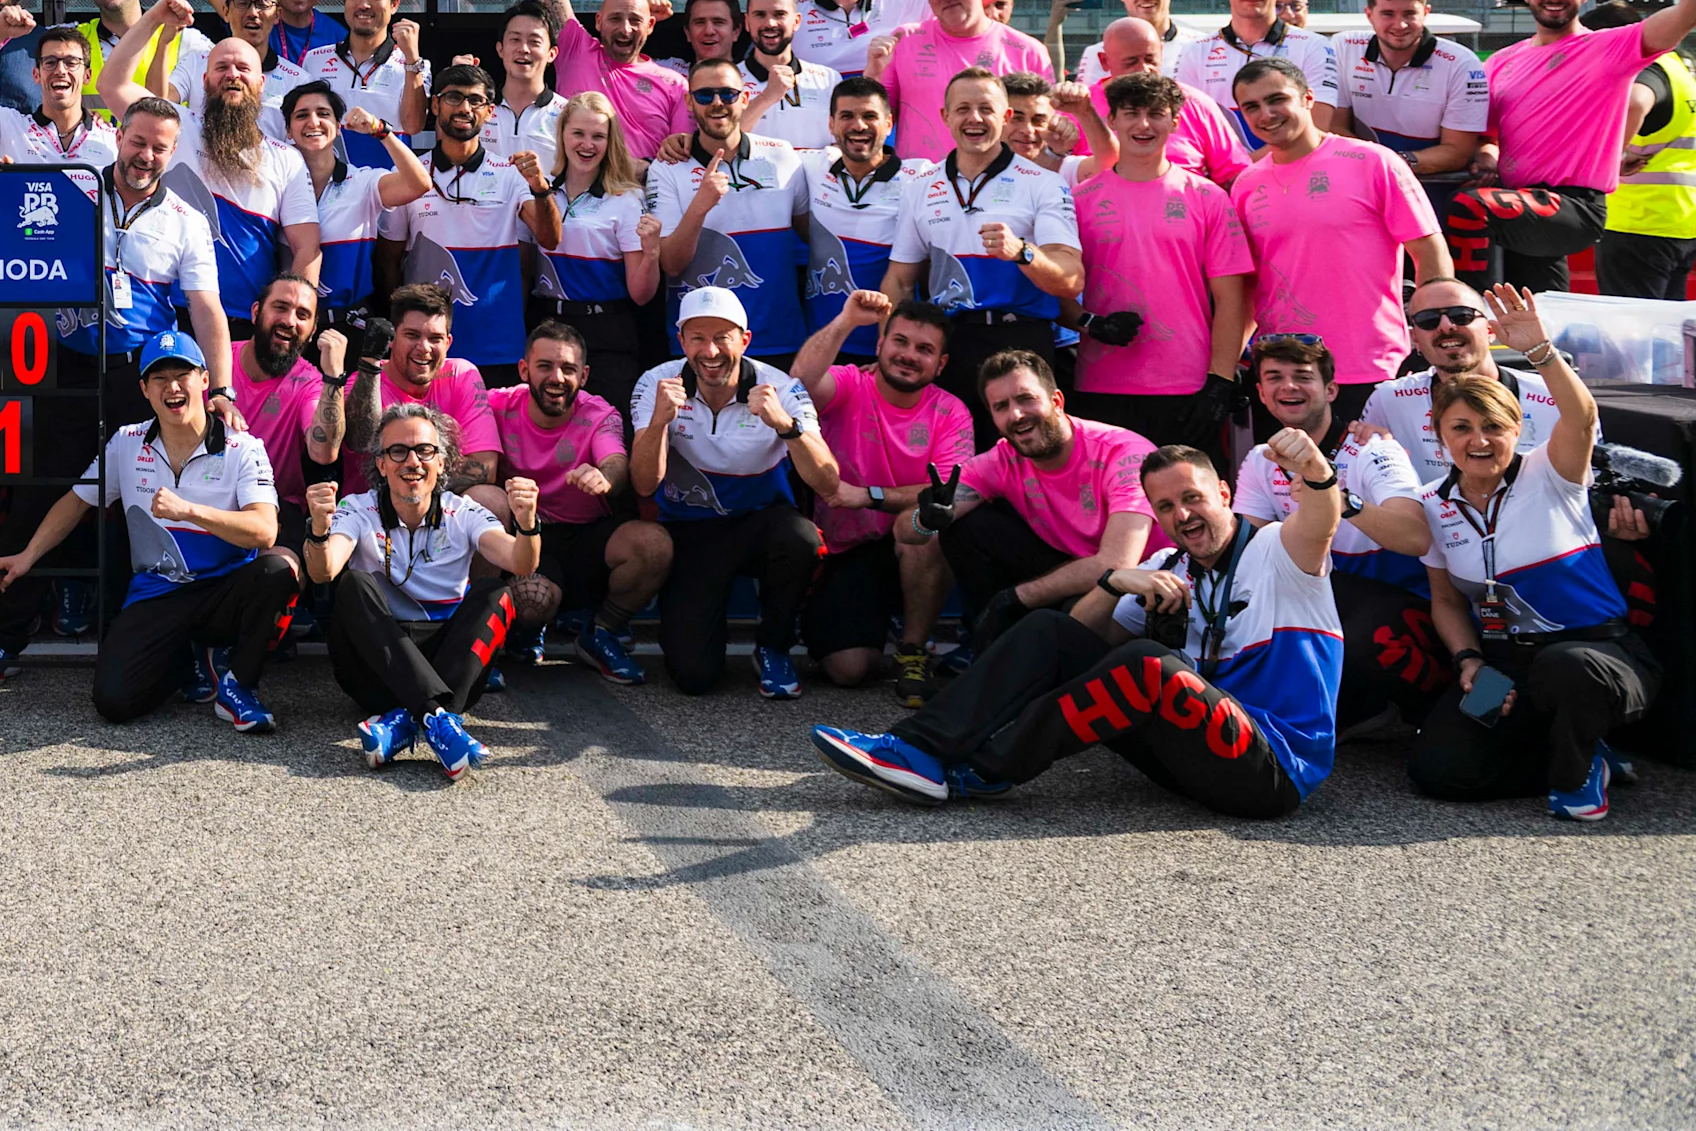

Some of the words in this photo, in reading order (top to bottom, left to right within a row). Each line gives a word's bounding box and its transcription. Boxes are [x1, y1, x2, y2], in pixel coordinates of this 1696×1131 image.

[1433, 49, 1456, 62] HUGO
[276, 62, 300, 77] HUGO
[1351, 91, 1373, 99] TUDOR
[1333, 150, 1366, 160] HUGO
[486, 159, 512, 169] HUGO
[1014, 164, 1041, 176] HUGO
[25, 182, 52, 192] VISA
[820, 183, 839, 193] HONDA
[1073, 182, 1104, 197] HUGO
[927, 191, 948, 199] ORLEN
[814, 198, 833, 209] TUDOR
[418, 211, 439, 219] TUDOR
[927, 217, 951, 225] TUDOR
[1448, 187, 1561, 271] HUGO
[1526, 392, 1556, 407] HUG
[225, 437, 239, 449] GO
[1421, 490, 1438, 501] HU
[1441, 520, 1464, 529] HONDA
[1445, 538, 1470, 549] TUDOR
[1059, 656, 1253, 759] HUGO
